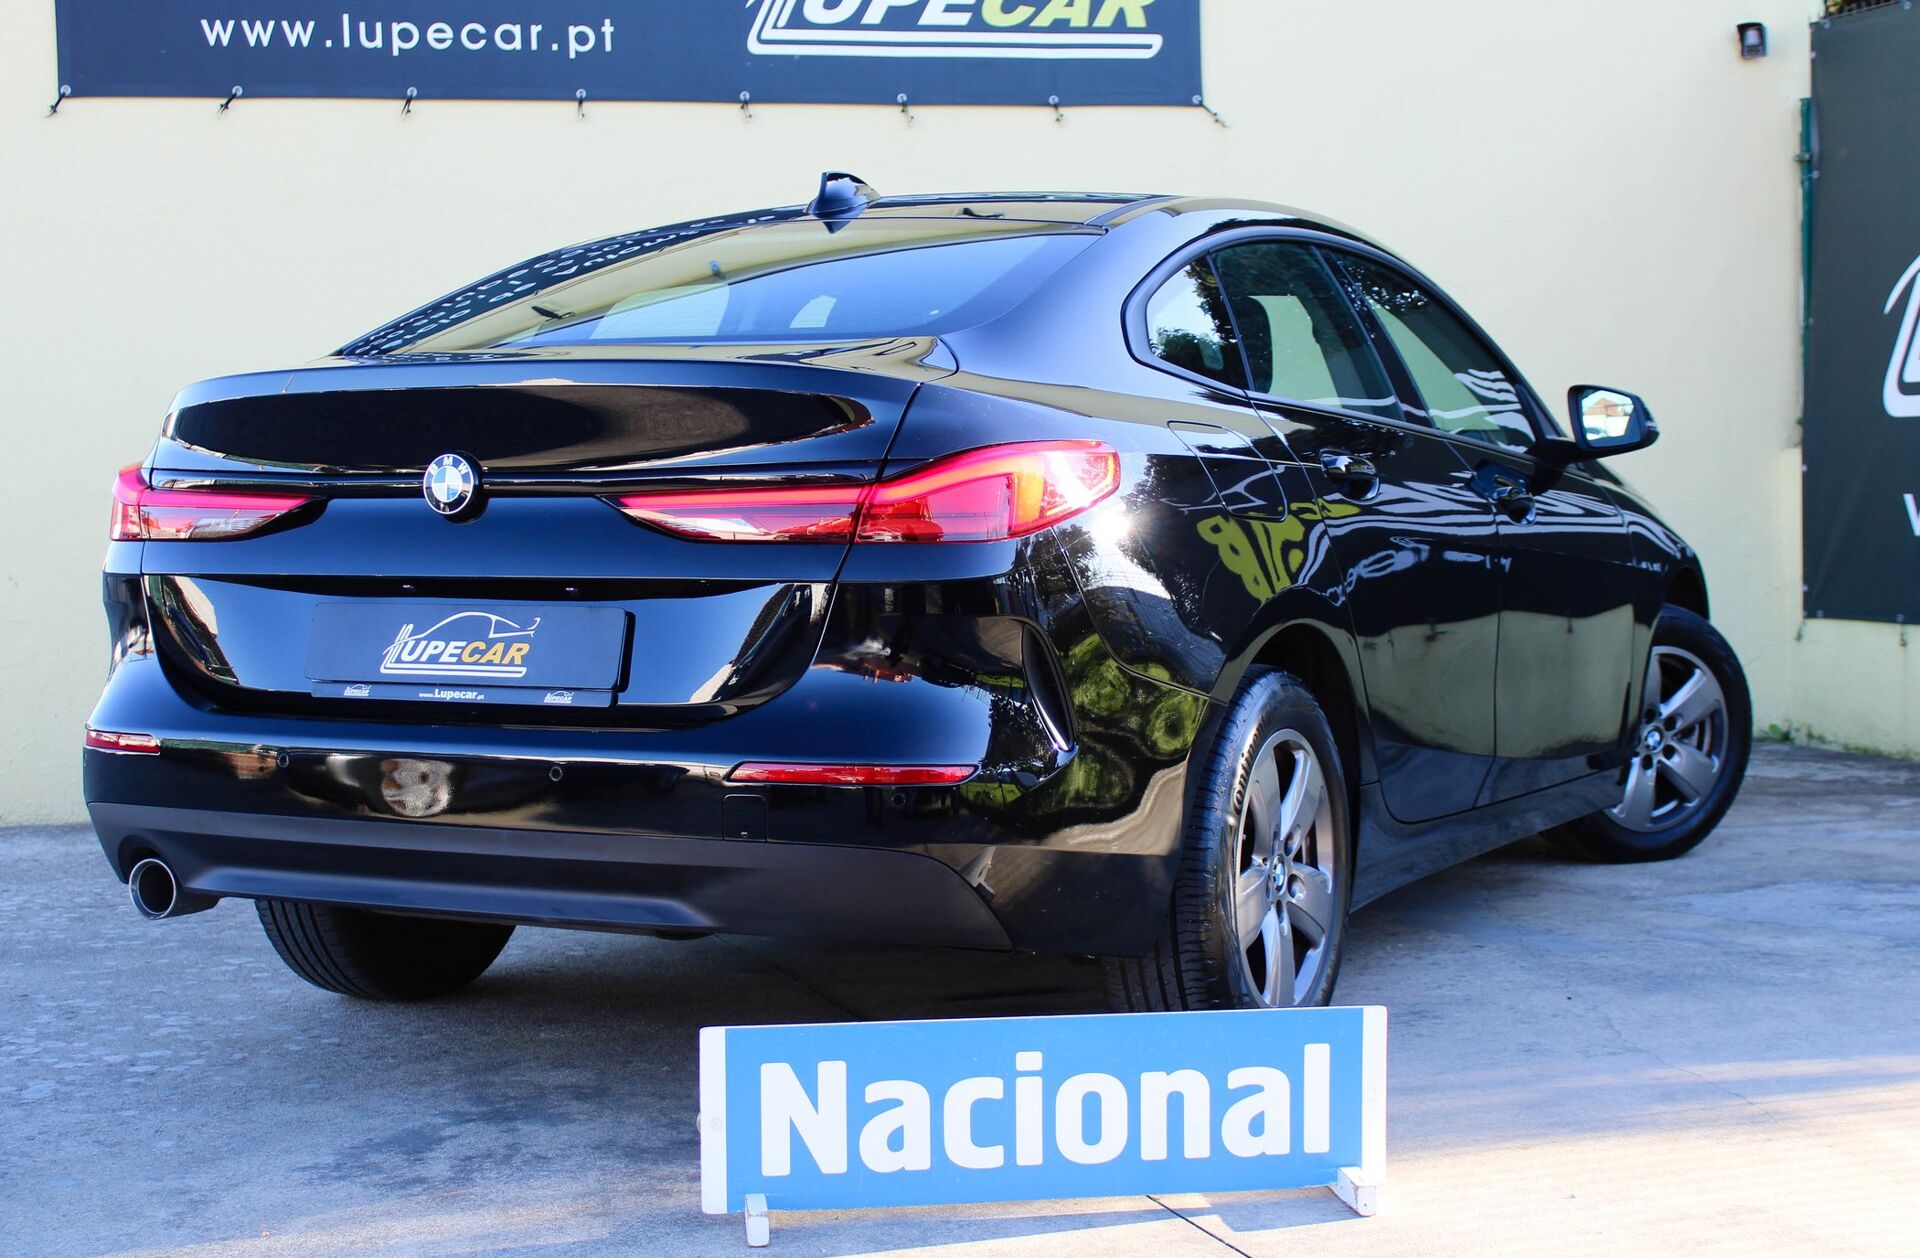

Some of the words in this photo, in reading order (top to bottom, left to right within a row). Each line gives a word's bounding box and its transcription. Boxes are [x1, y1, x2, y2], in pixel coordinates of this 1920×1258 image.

[201, 14, 616, 59] www.lupecar.pt
[429, 456, 469, 475] BMW
[759, 1042, 1331, 1177] Nacional
